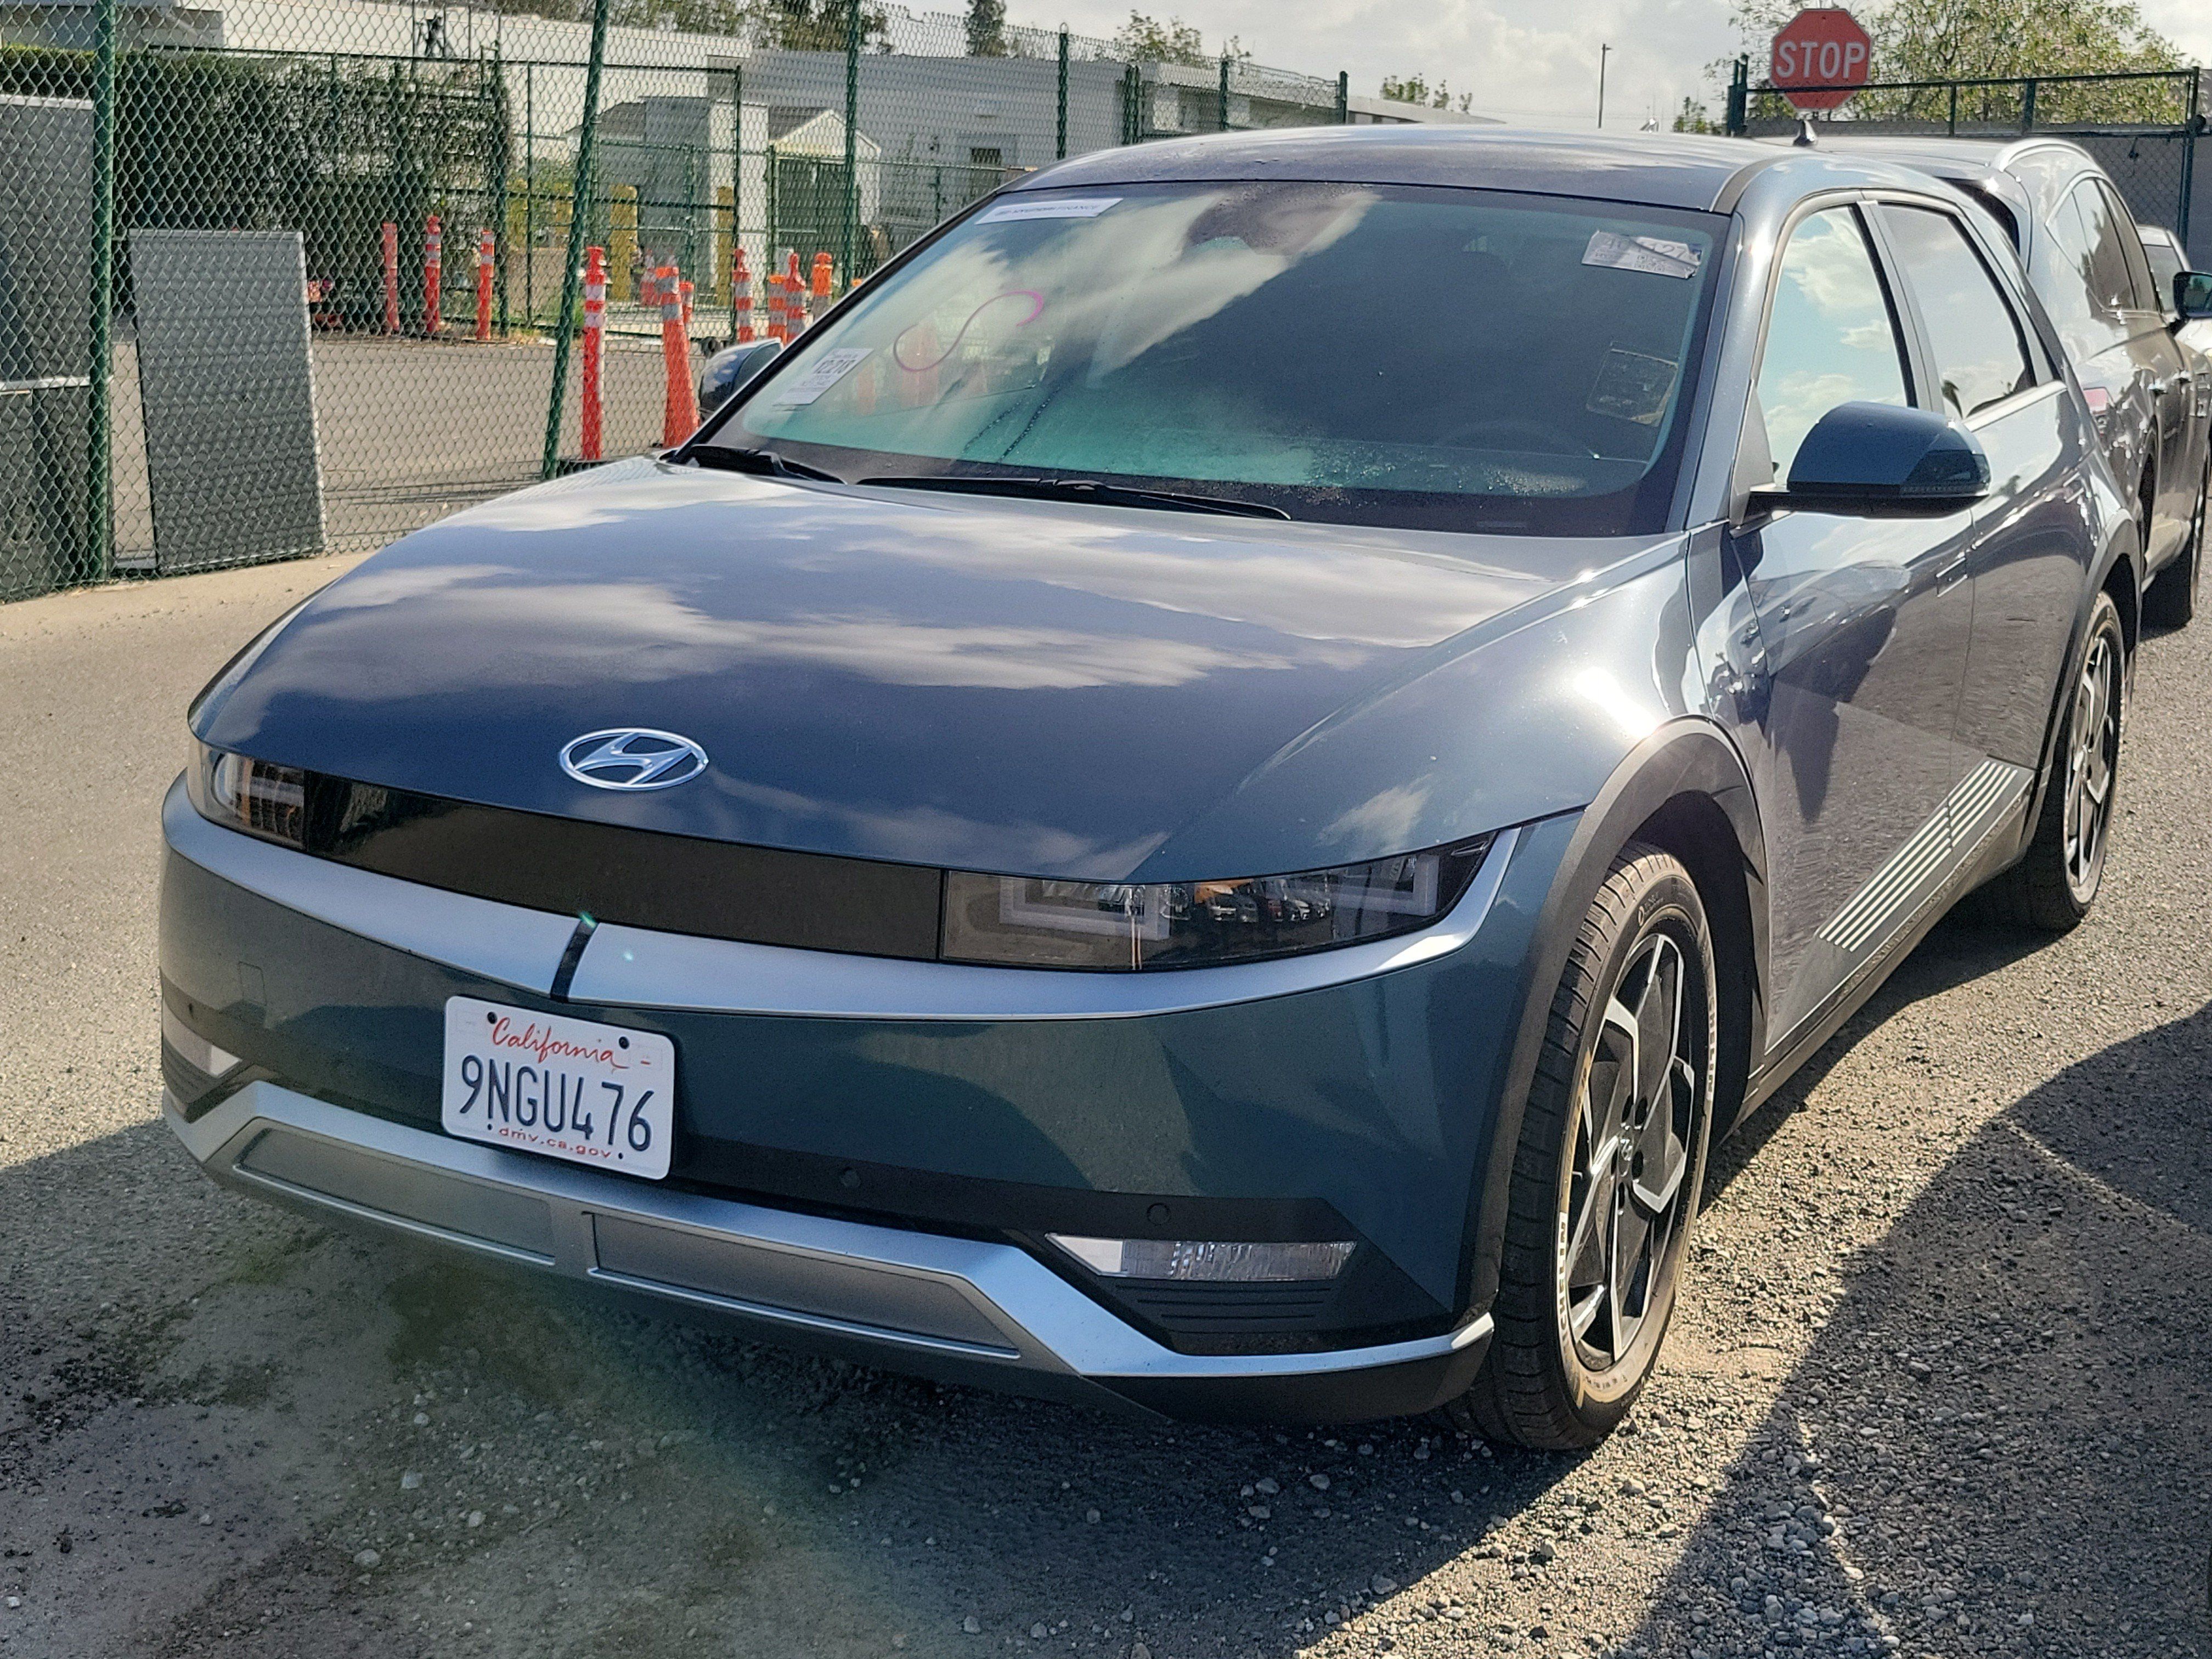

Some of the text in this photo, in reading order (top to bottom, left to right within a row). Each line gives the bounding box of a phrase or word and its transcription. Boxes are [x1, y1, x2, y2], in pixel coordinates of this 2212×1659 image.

[1776, 41, 1865, 78] STOP
[493, 1017, 629, 1069] California
[460, 1054, 654, 1152] 9NGU476
[498, 1126, 611, 1159] dmv.ca.gov
